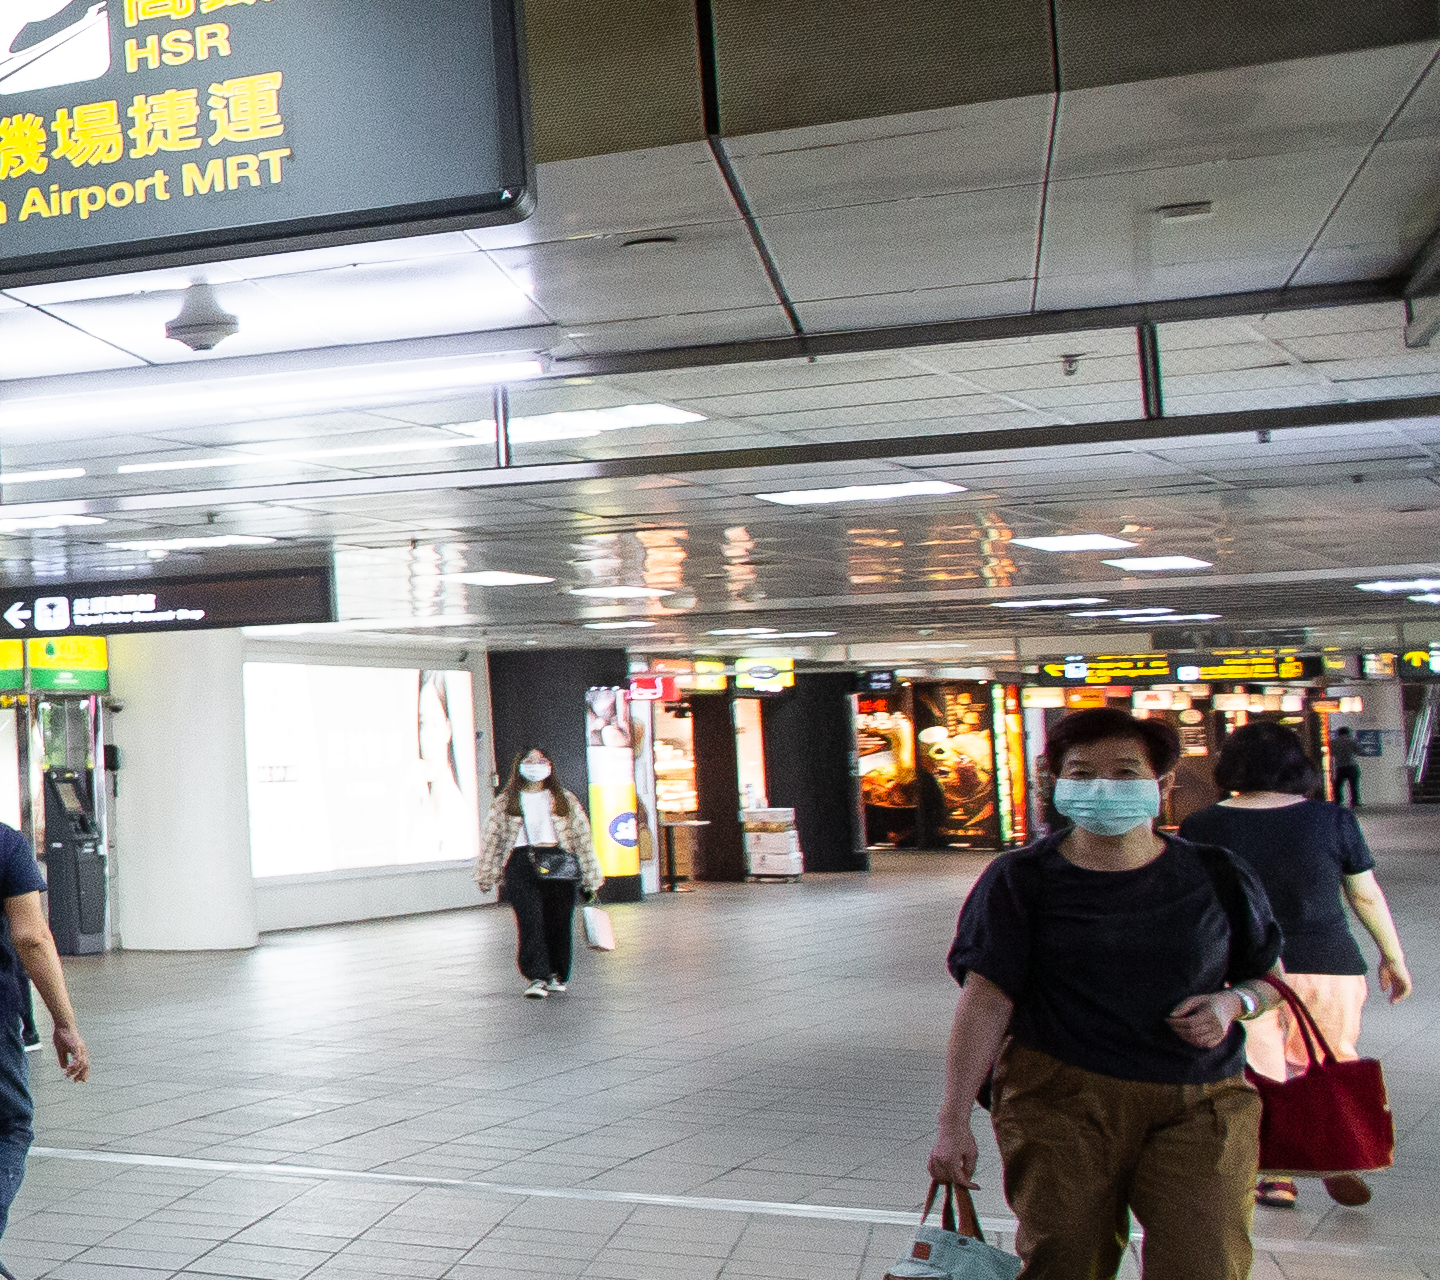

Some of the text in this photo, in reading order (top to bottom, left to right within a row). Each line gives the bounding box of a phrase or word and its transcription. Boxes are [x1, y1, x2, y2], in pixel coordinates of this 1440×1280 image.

[125, 24, 231, 74] HSR
[19, 170, 169, 224] Airport
[181, 148, 292, 196] MRT
